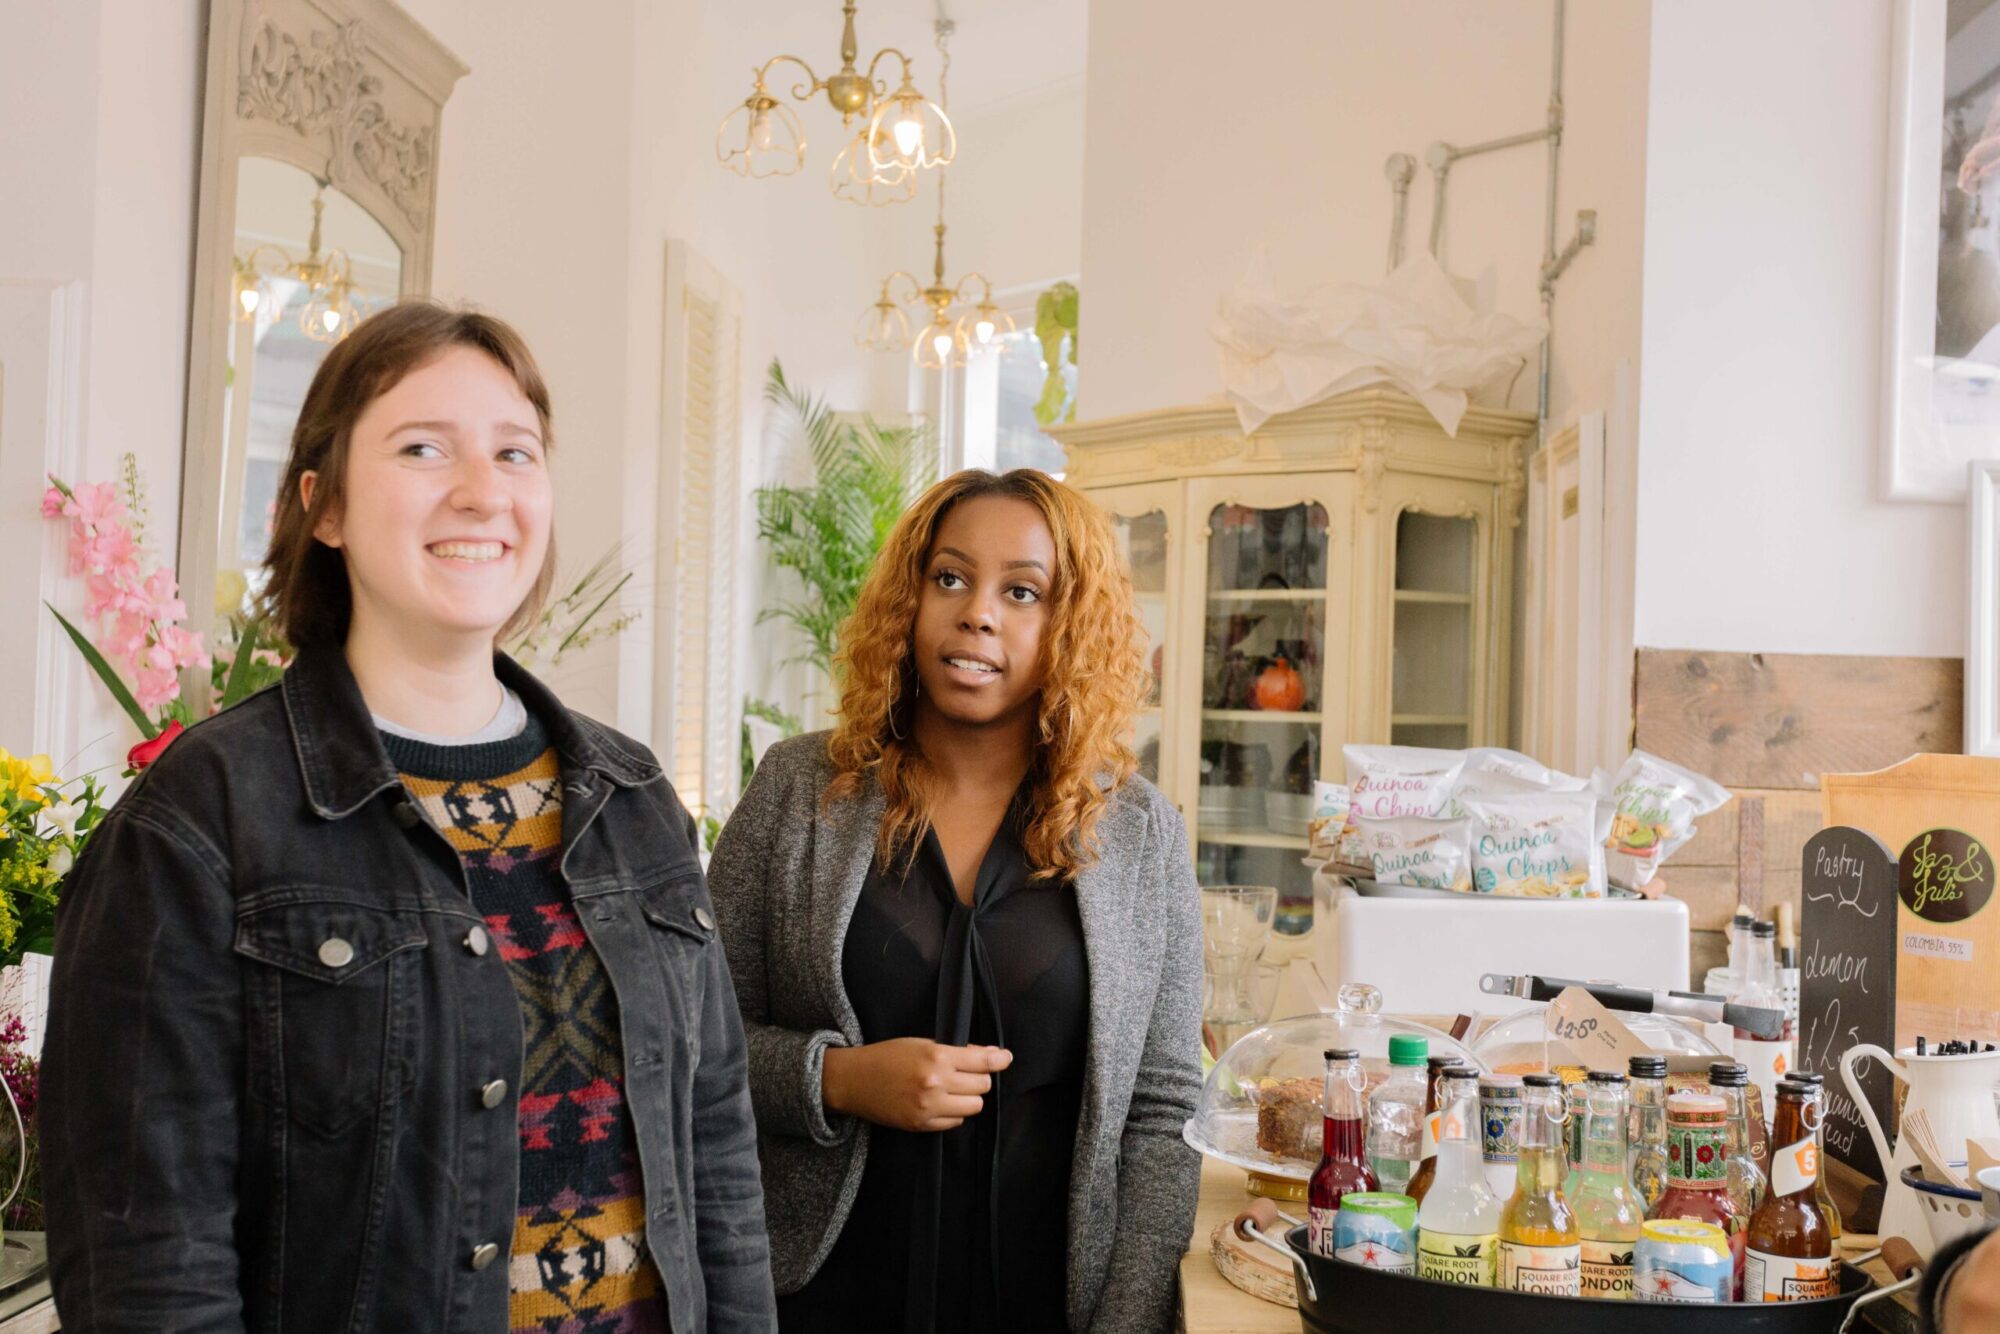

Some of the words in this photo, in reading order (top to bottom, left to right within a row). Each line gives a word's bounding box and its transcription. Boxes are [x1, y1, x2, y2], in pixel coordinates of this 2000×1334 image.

[1354, 774, 1427, 794] Quinoa
[1480, 831, 1558, 856] Quinoa
[1372, 850, 1436, 875] Quinoa
[1506, 851, 1571, 886] Chips
[1814, 843, 1865, 902] Pastry
[1904, 935, 1945, 952] COLOMBIA
[1804, 1150, 1816, 1172] 5
[1452, 1260, 1480, 1270] ROOT
[1581, 1266, 1606, 1277] UARE
[1608, 1269, 1633, 1277] ROOT
[1521, 1271, 1560, 1283] SQUARE
[1580, 1276, 1634, 1292] ONDON
[1787, 1282, 1824, 1293] SQUARE
